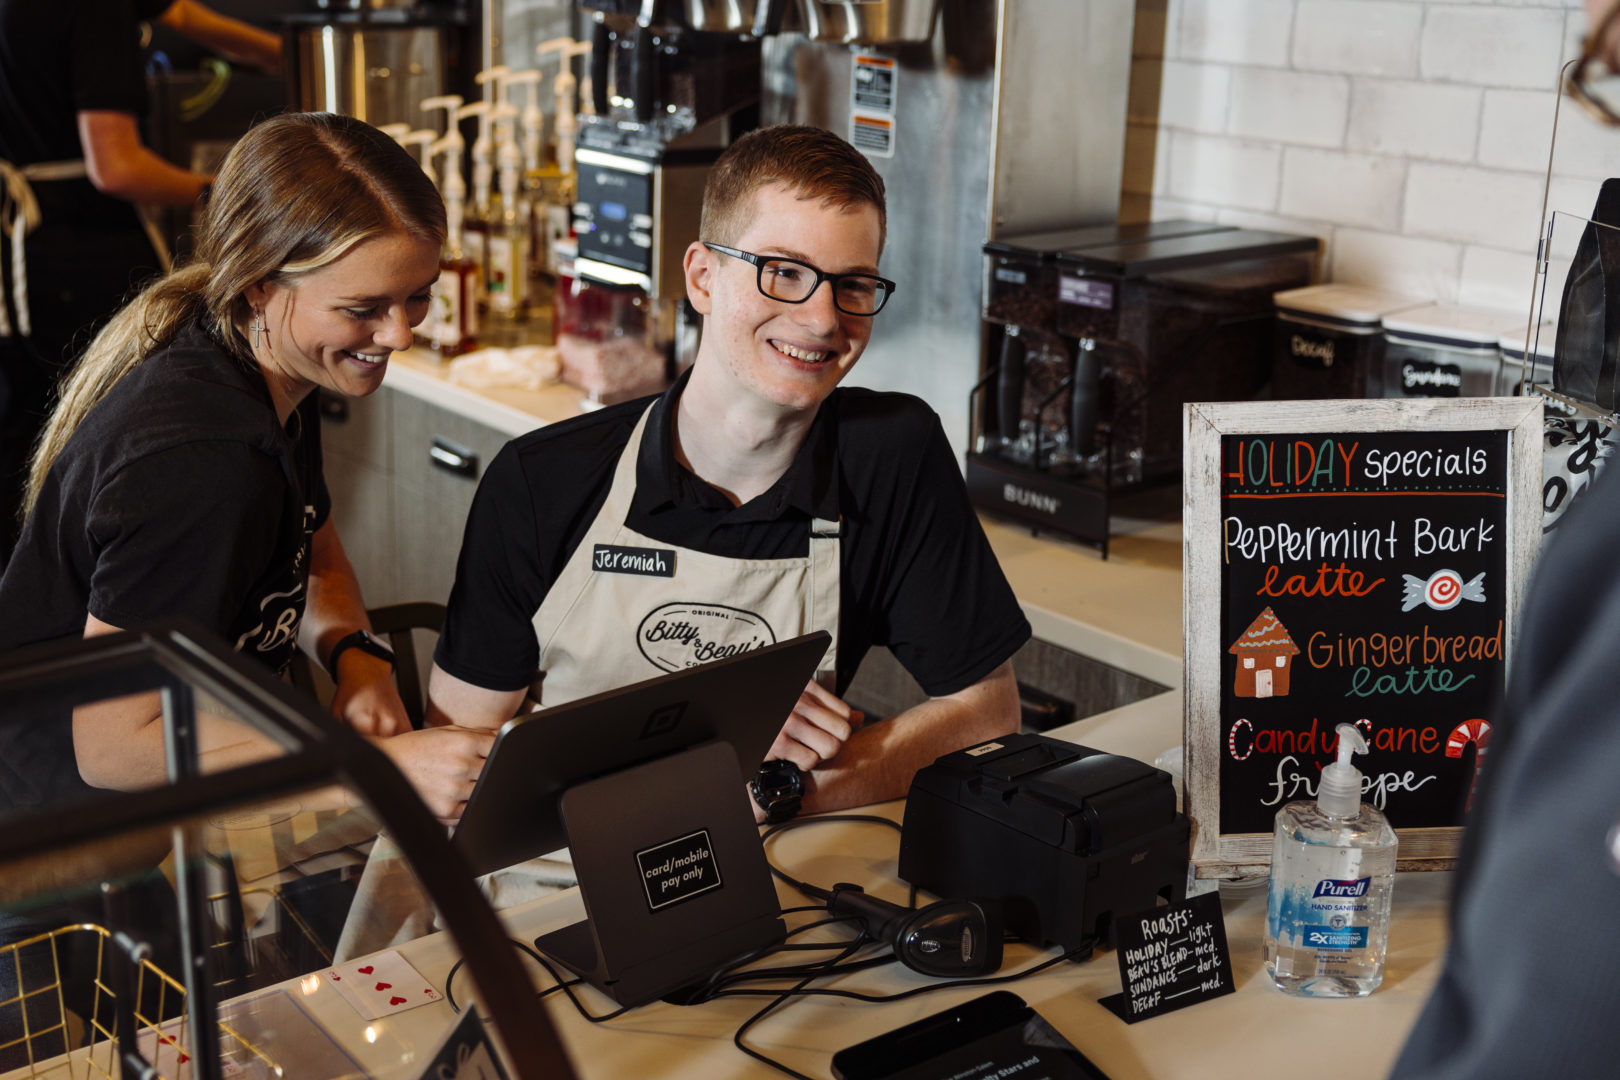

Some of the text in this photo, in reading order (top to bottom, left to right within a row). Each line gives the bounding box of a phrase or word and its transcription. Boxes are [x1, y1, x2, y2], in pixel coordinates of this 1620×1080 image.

[1221, 439, 1487, 487] HOLIDAY specials
[1224, 516, 1494, 564] Peppermint Bark
[595, 549, 666, 572] Jeremiah
[1256, 562, 1386, 597] latte
[691, 610, 729, 619] ORIGINAL
[645, 620, 700, 645] Bitty
[1307, 620, 1504, 669] Gingerbread
[1345, 664, 1476, 698] latte
[1260, 756, 1436, 811] frpe
[646, 847, 709, 878] card/mobile
[661, 865, 703, 893] pay only
[1320, 880, 1365, 896] Purell
[1141, 909, 1193, 940] Roasts:
[1125, 922, 1212, 965] HOLIDAY light
[1127, 959, 1159, 983] BEAU'S
[1161, 947, 1188, 970] BLEND
[1130, 953, 1221, 998] SUNDANCE dark
[1132, 991, 1161, 1014] DECAF
